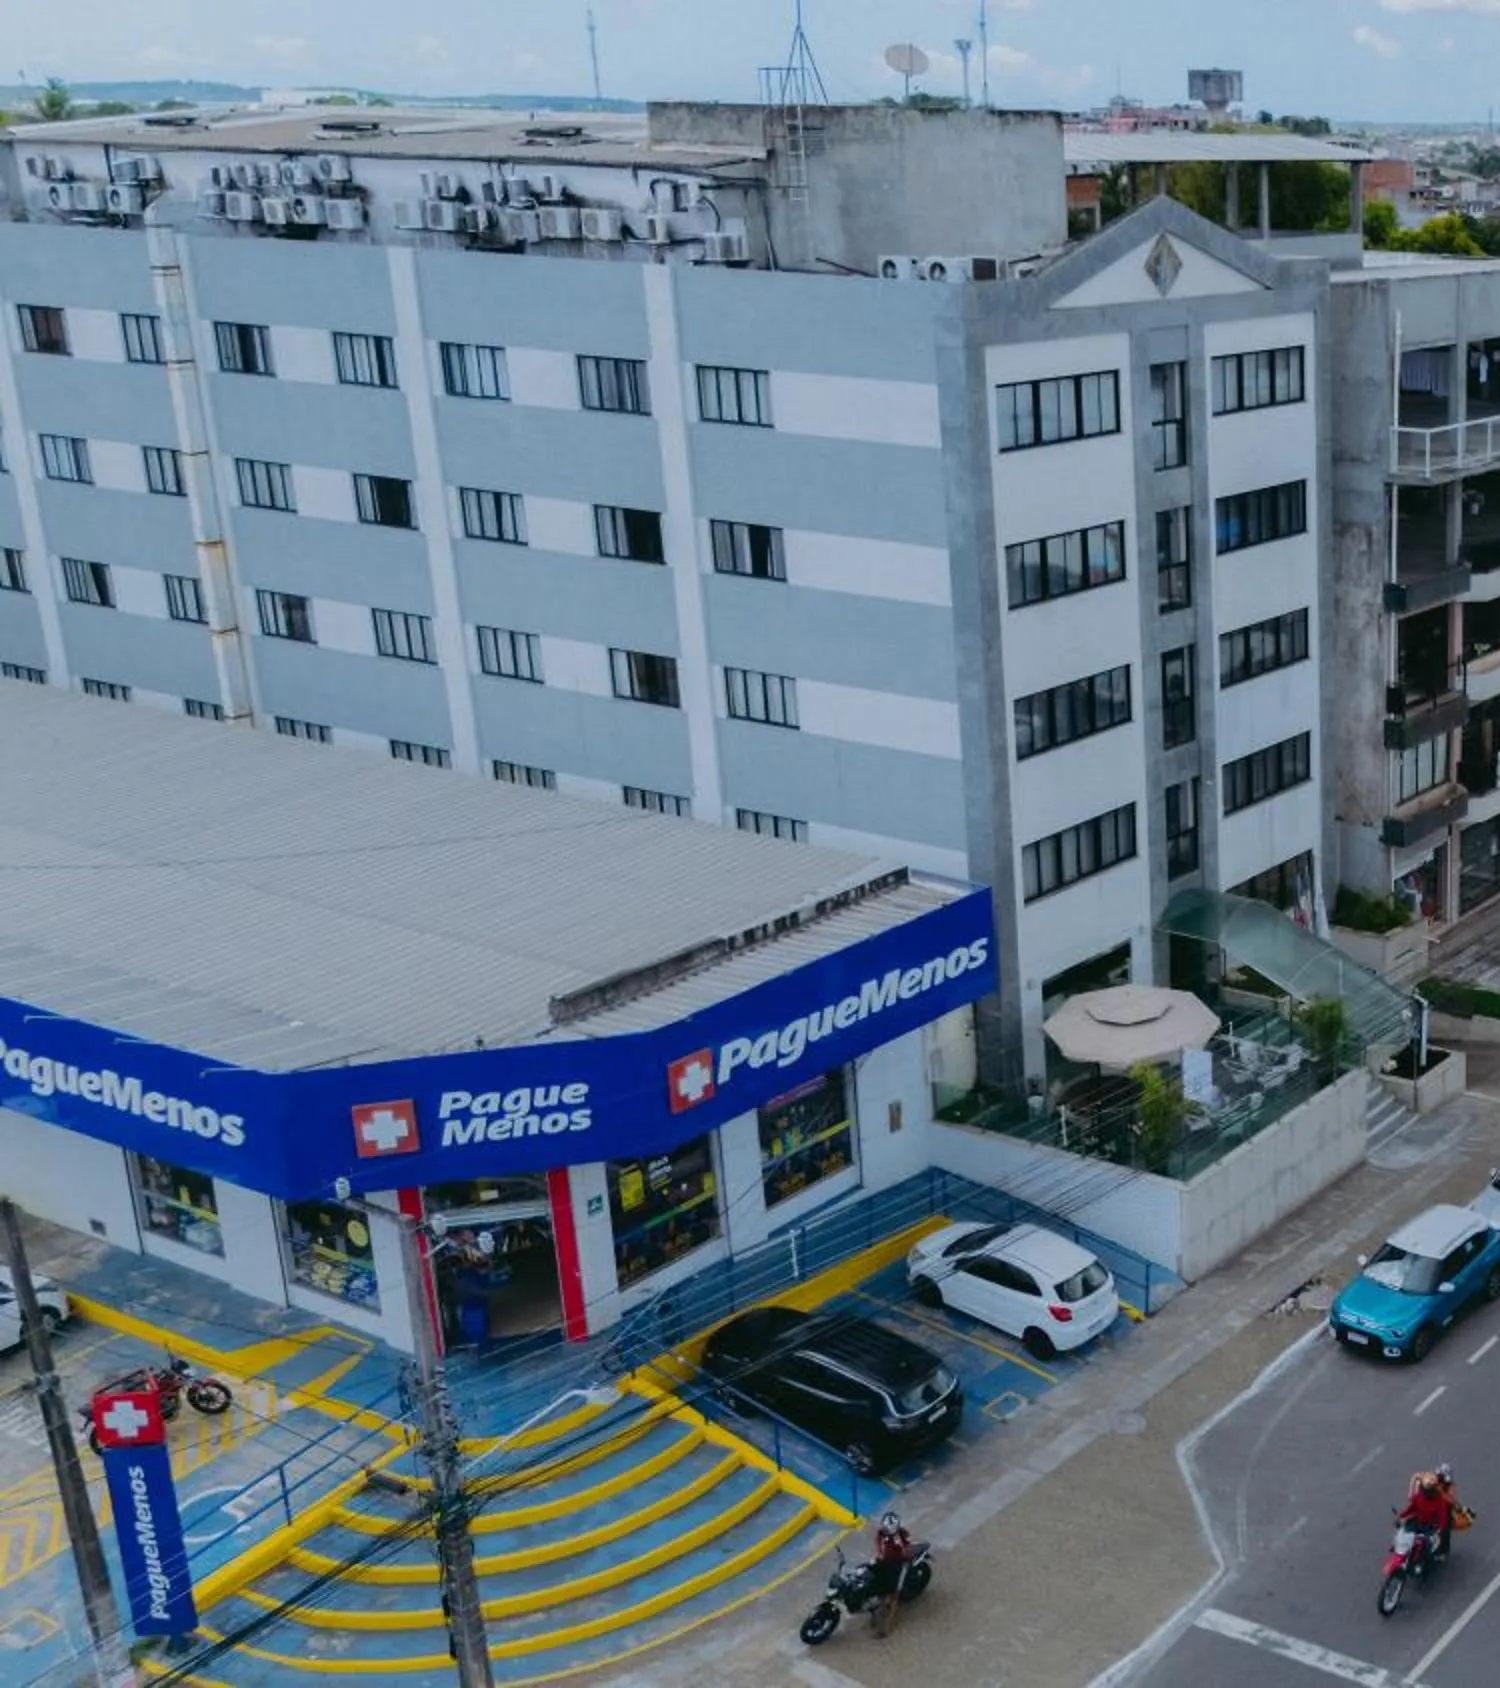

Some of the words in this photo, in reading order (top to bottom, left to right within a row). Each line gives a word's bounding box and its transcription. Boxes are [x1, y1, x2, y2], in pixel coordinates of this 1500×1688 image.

[717, 937, 989, 1085] PagueMenos
[0, 1037, 246, 1147] agueMenos
[438, 1081, 590, 1119] Pague
[441, 1108, 593, 1147] Menos
[128, 1464, 171, 1621] PagueMenos
